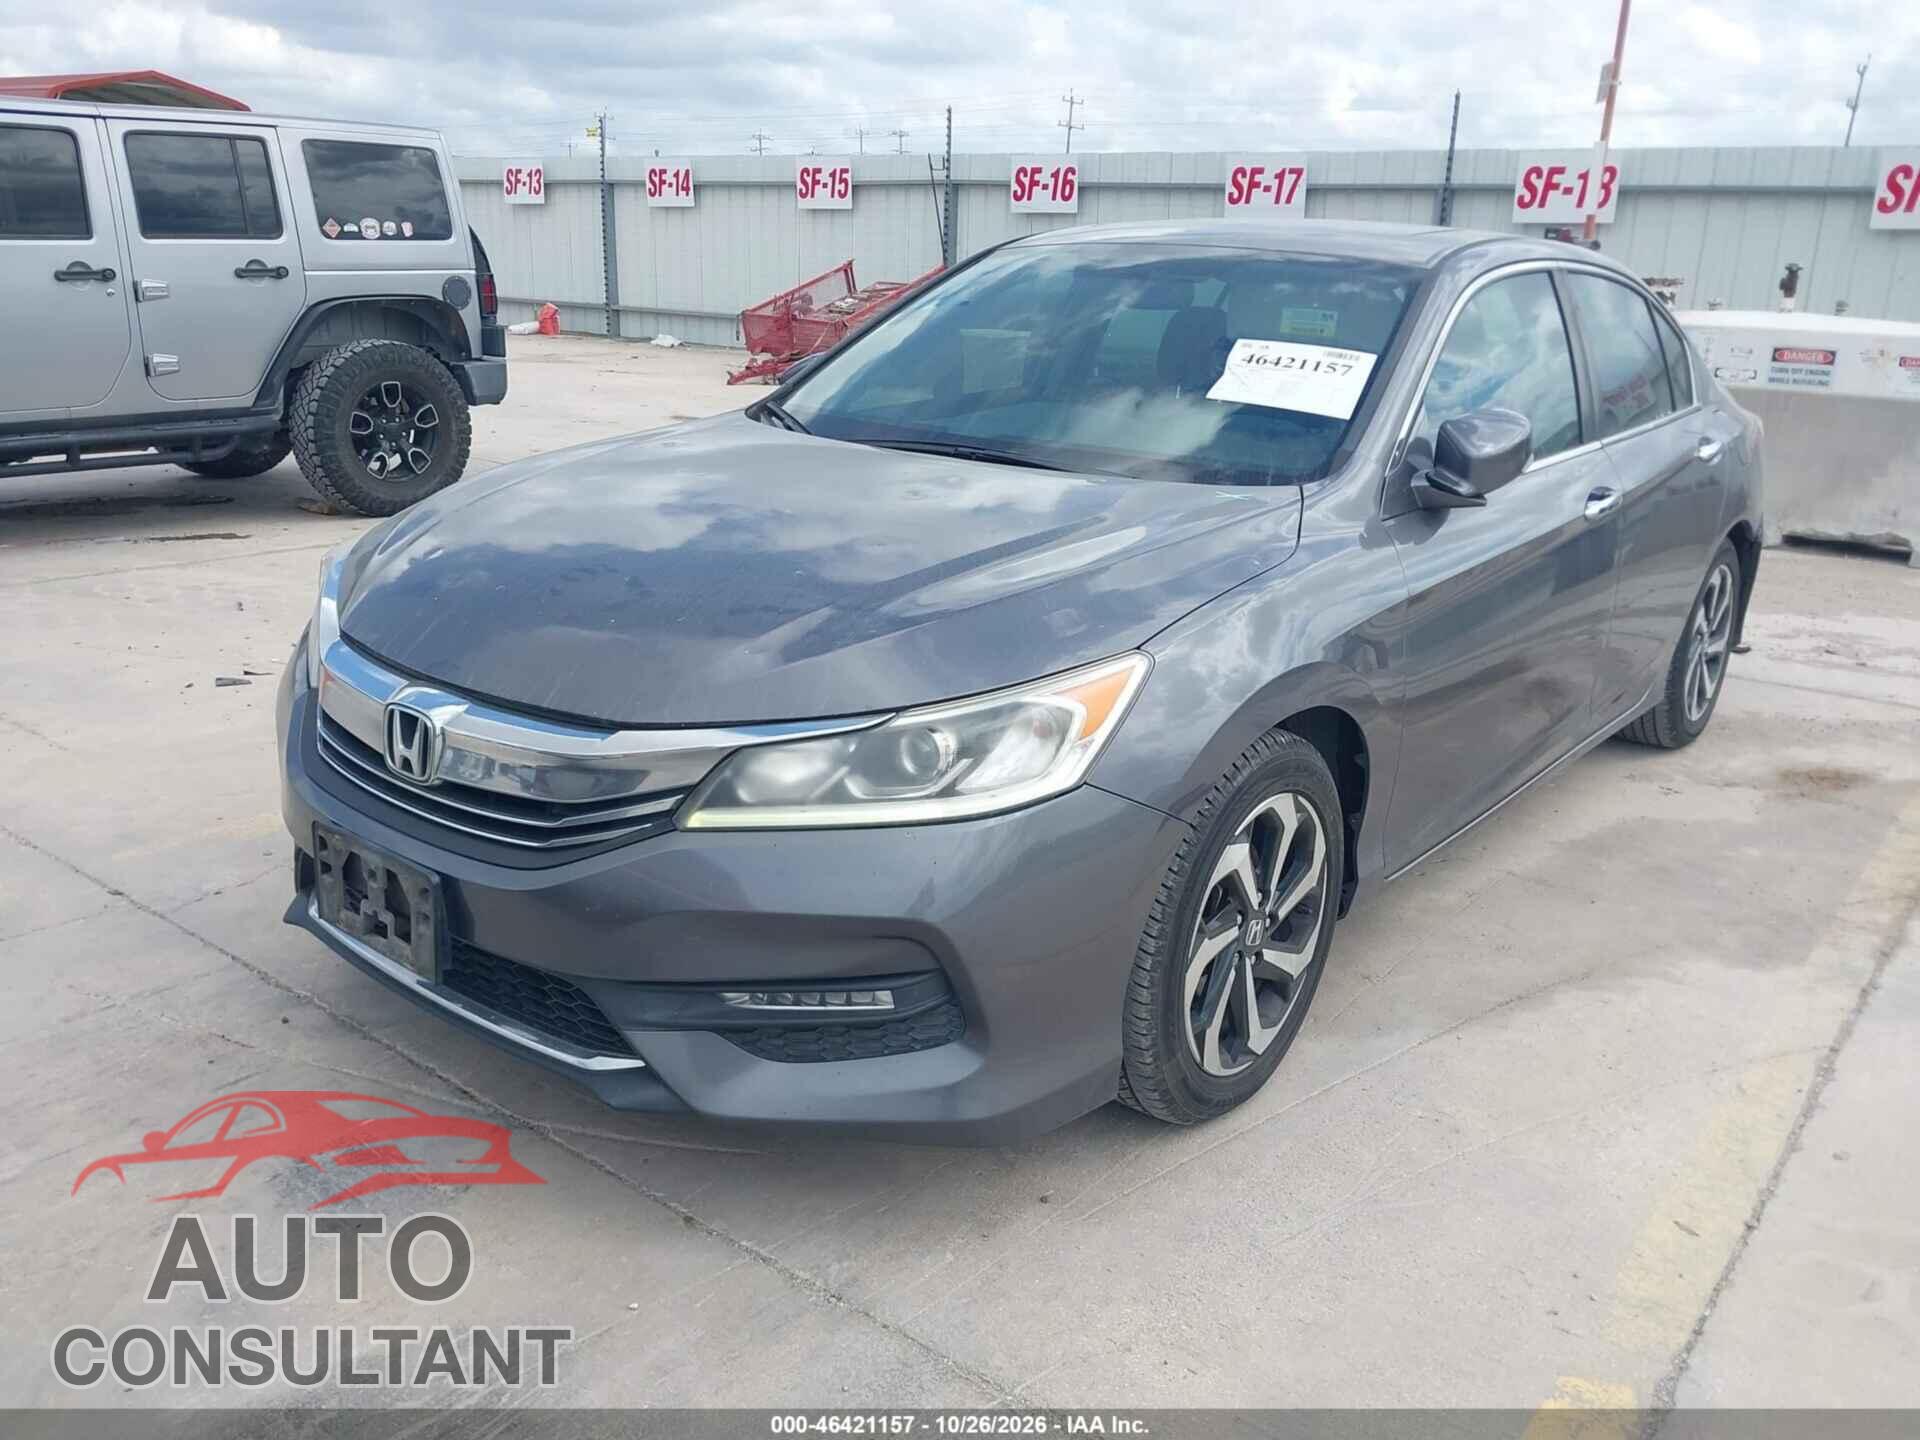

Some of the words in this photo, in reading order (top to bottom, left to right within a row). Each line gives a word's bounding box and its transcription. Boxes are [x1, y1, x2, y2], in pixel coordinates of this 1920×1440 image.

[505, 168, 543, 196] SF-13
[648, 168, 692, 197] SF-14
[798, 167, 850, 200] SF-15
[1012, 166, 1077, 203] SF-16
[1226, 166, 1305, 206] SF-17
[1241, 353, 1354, 377] 46421157
[1783, 350, 1824, 363] DANGER
